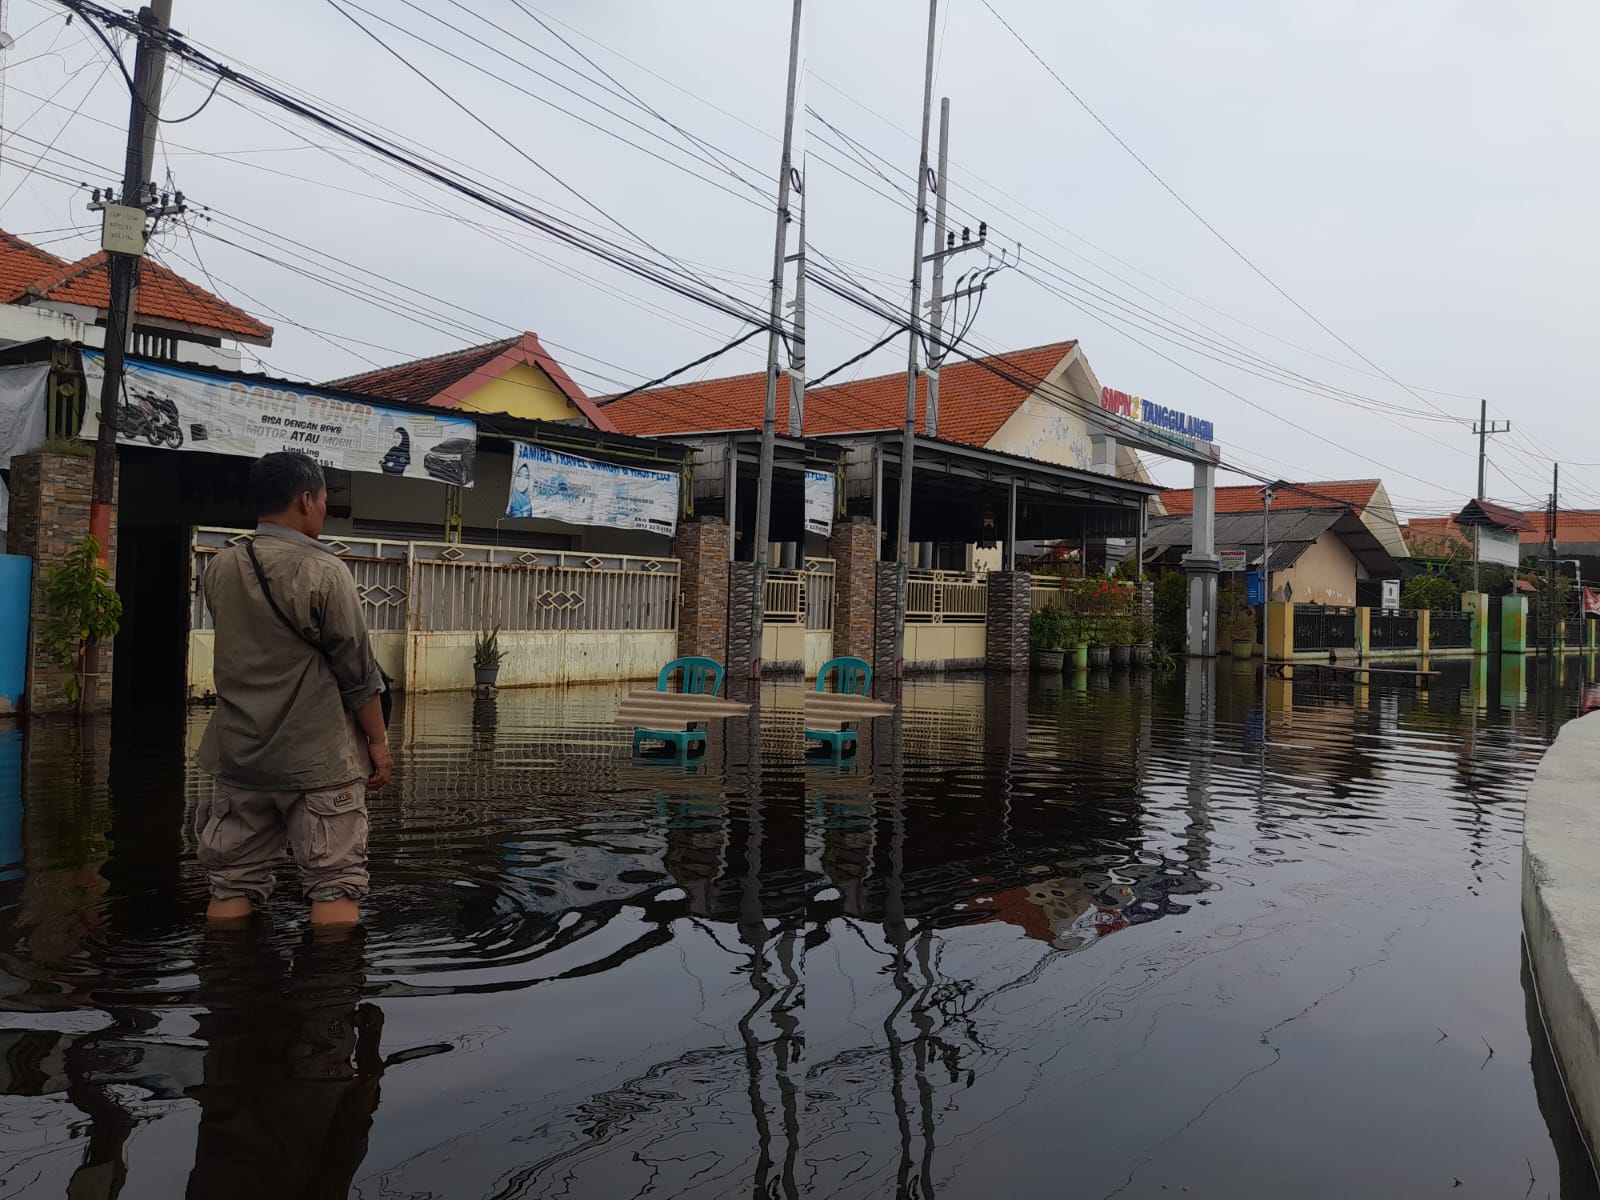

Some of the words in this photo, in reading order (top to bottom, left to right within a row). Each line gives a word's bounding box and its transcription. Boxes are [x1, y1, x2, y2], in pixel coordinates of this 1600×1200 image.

[229, 383, 298, 415] DANA
[304, 396, 373, 426] TUNAI
[1101, 386, 1132, 416] SMPN
[1132, 396, 1140, 420] 2
[246, 424, 287, 439] MOTOR
[289, 430, 320, 444] ATAU
[261, 414, 282, 427] BISA
[284, 418, 318, 432] DENGAN
[319, 423, 342, 435] BPKB
